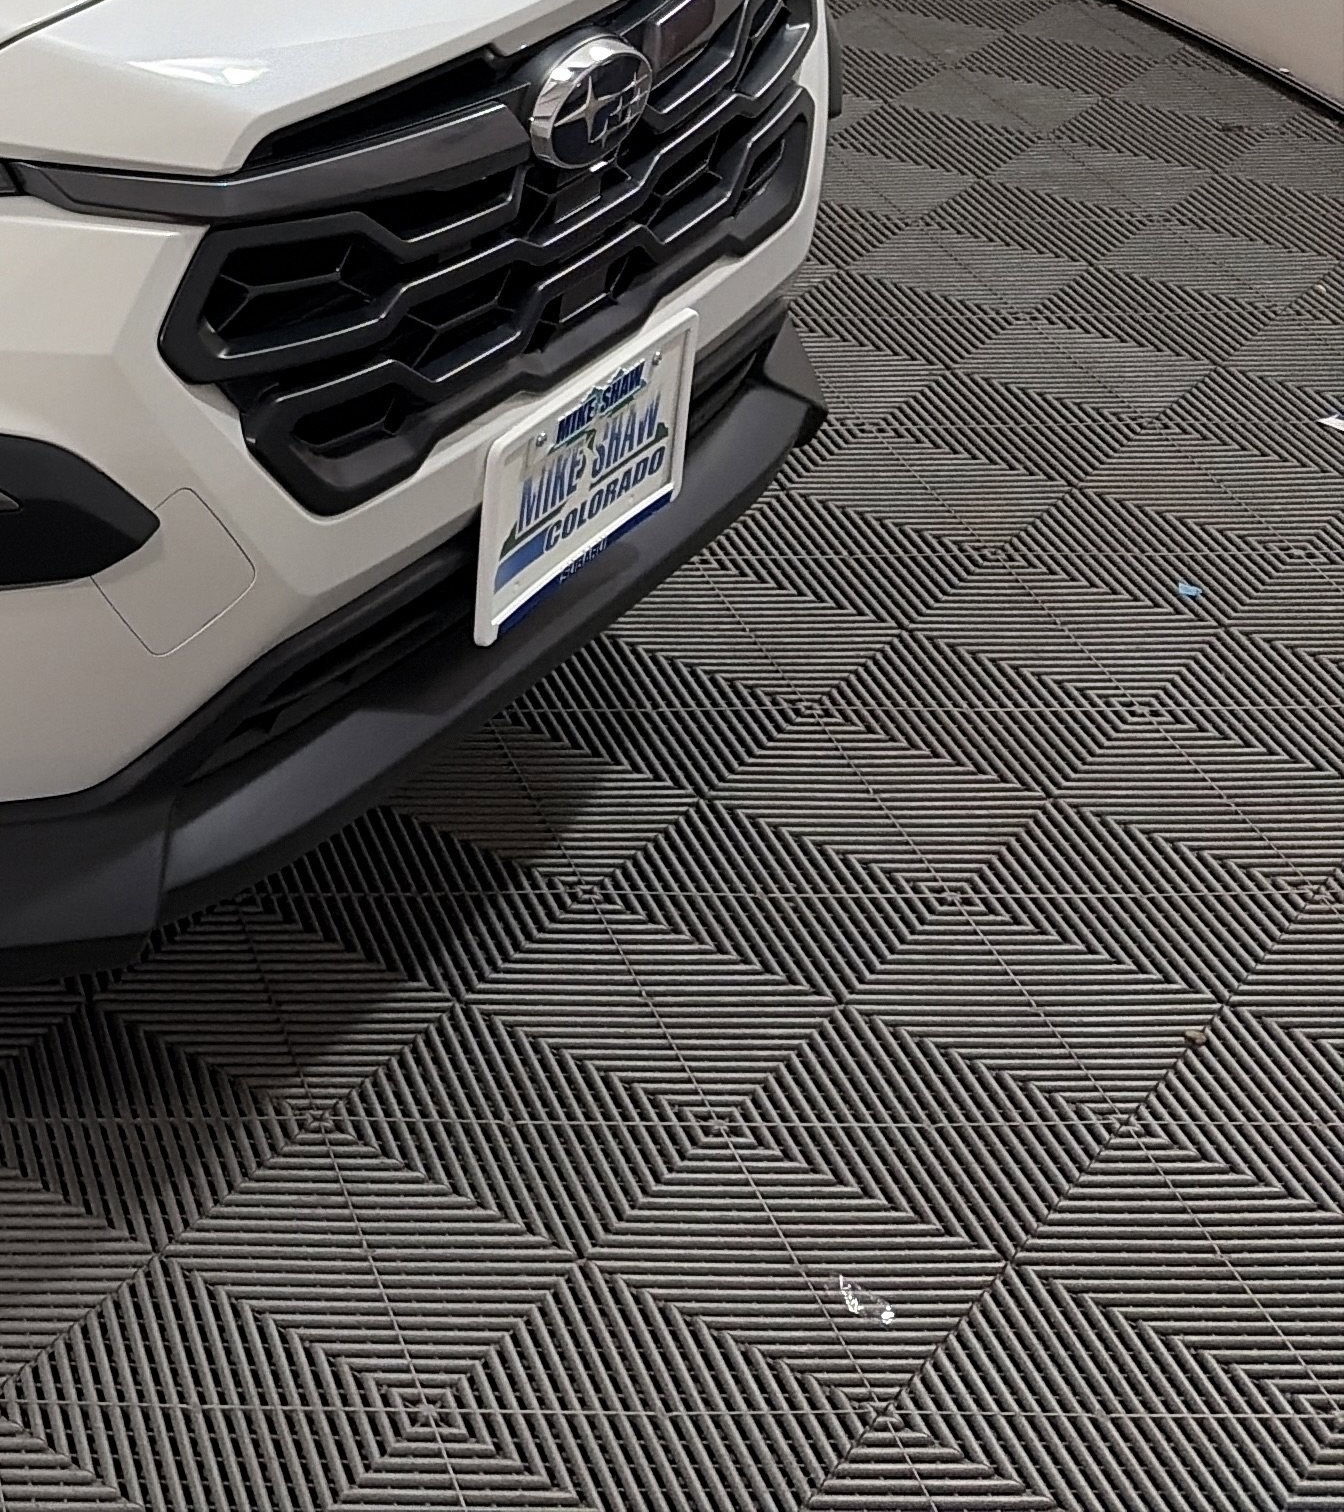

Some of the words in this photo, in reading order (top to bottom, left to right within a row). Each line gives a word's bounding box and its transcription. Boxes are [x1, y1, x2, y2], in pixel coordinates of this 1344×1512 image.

[555, 396, 596, 443] MIKE
[600, 360, 646, 413] SHAW
[518, 447, 585, 534] MIKE
[591, 391, 661, 480] SHAW
[546, 446, 666, 551] COLORADO
[559, 538, 609, 584] SUBARU
